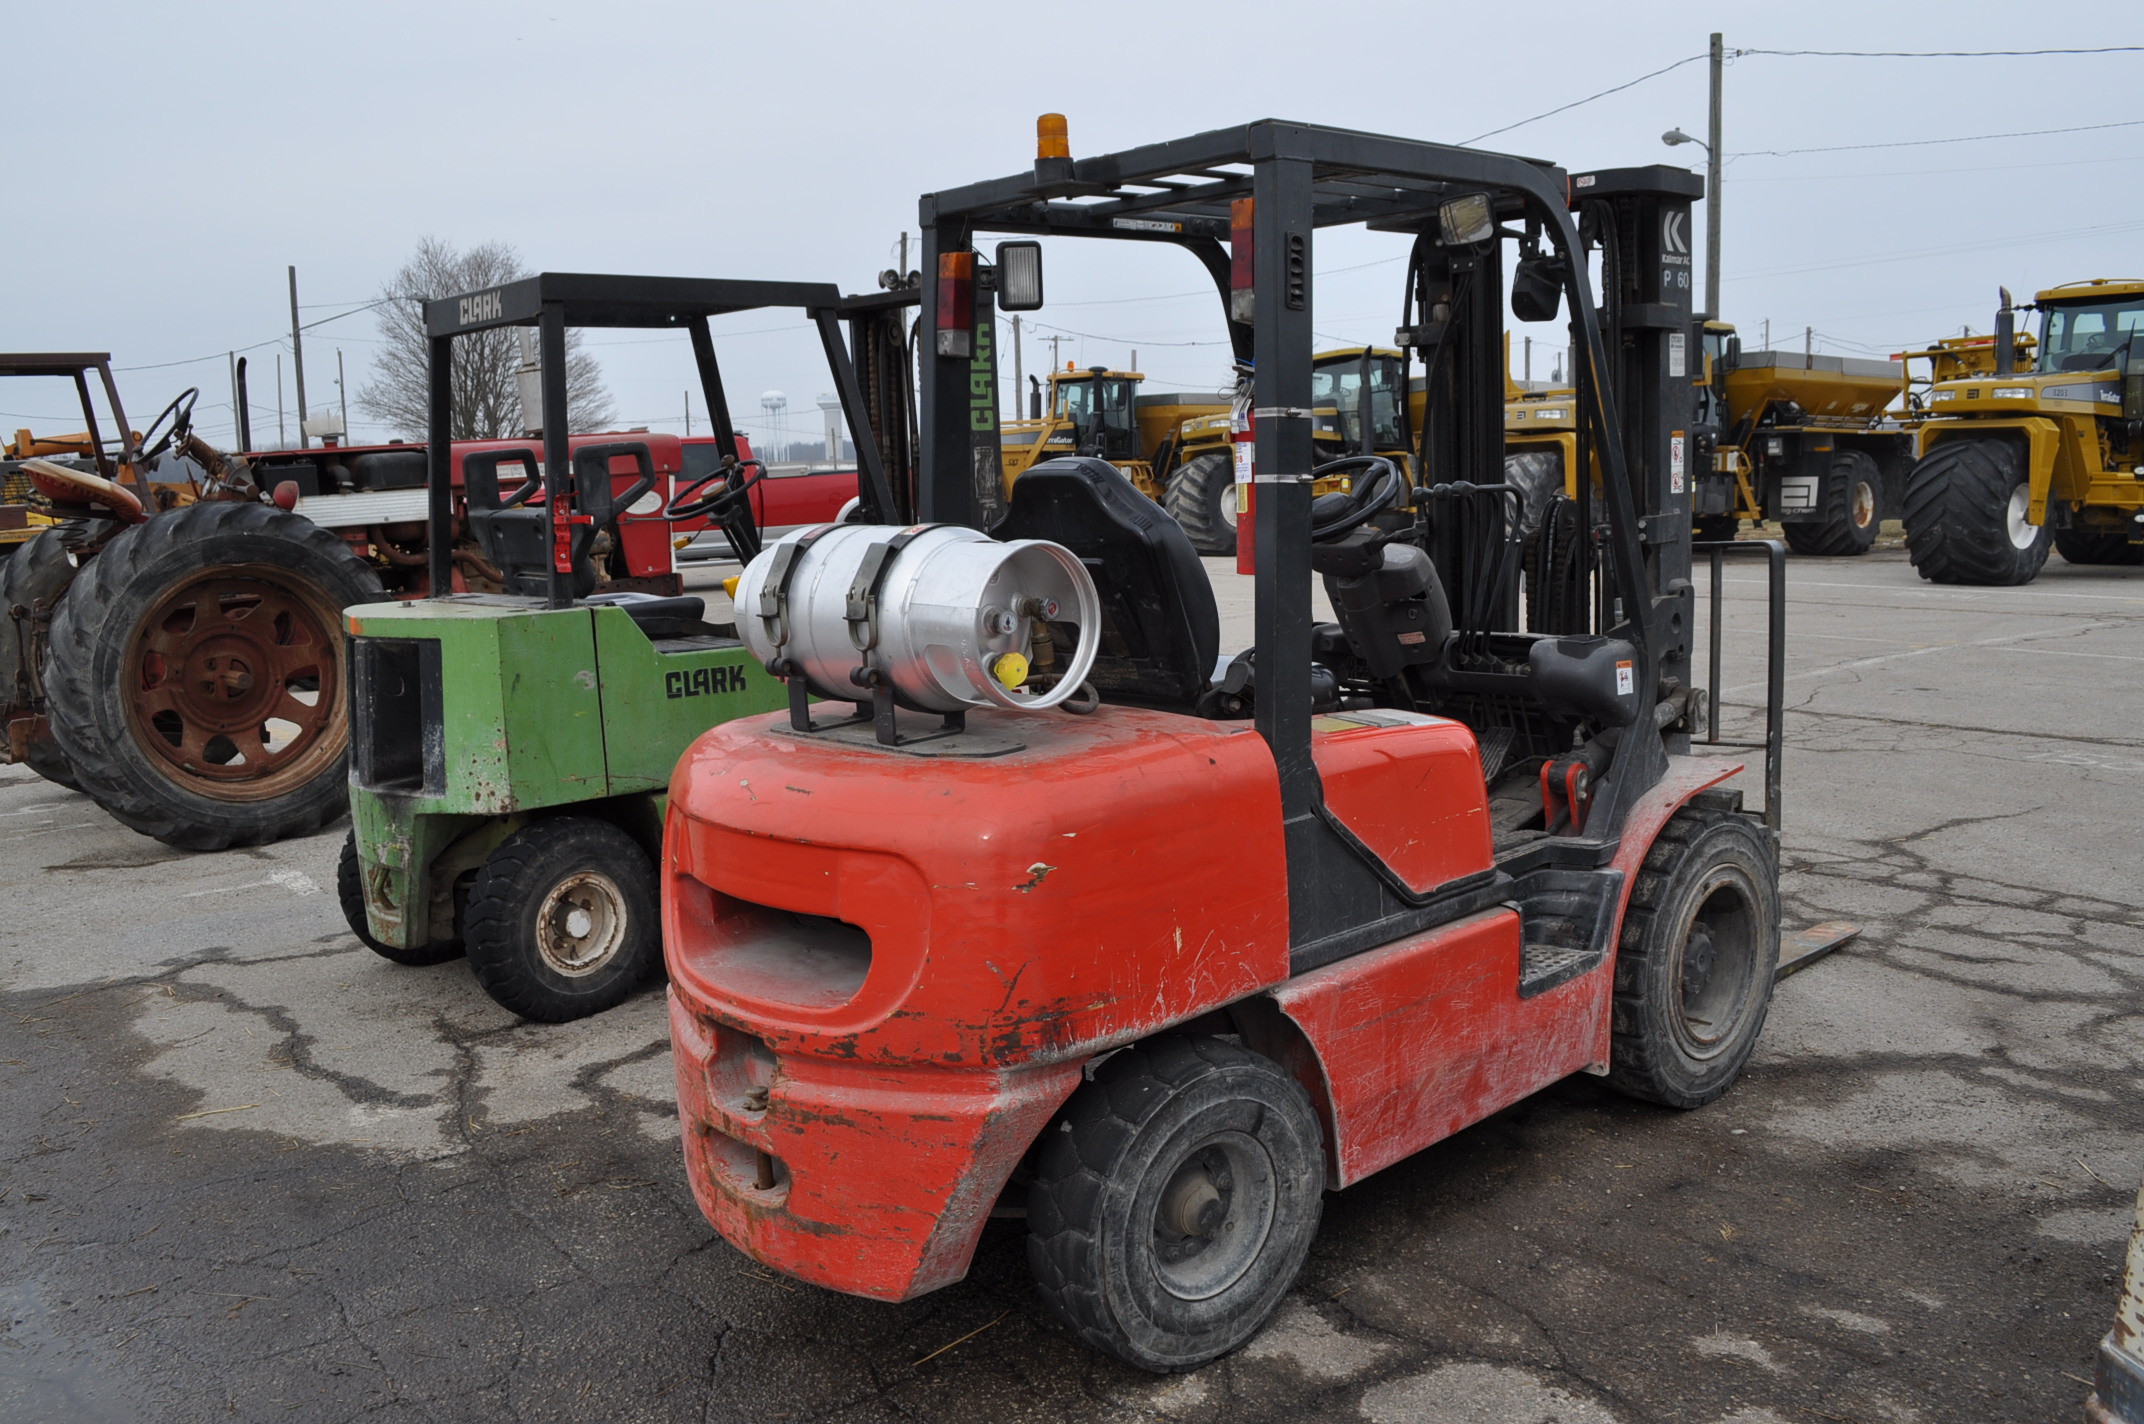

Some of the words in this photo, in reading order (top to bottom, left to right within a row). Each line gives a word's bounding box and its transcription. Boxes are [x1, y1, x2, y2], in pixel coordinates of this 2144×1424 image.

[1661, 253, 1682, 265] Kalmar
[1663, 269, 1671, 287] P
[1677, 271, 1689, 289] 60
[459, 290, 502, 326] CLARK
[665, 664, 747, 699] CLARK
